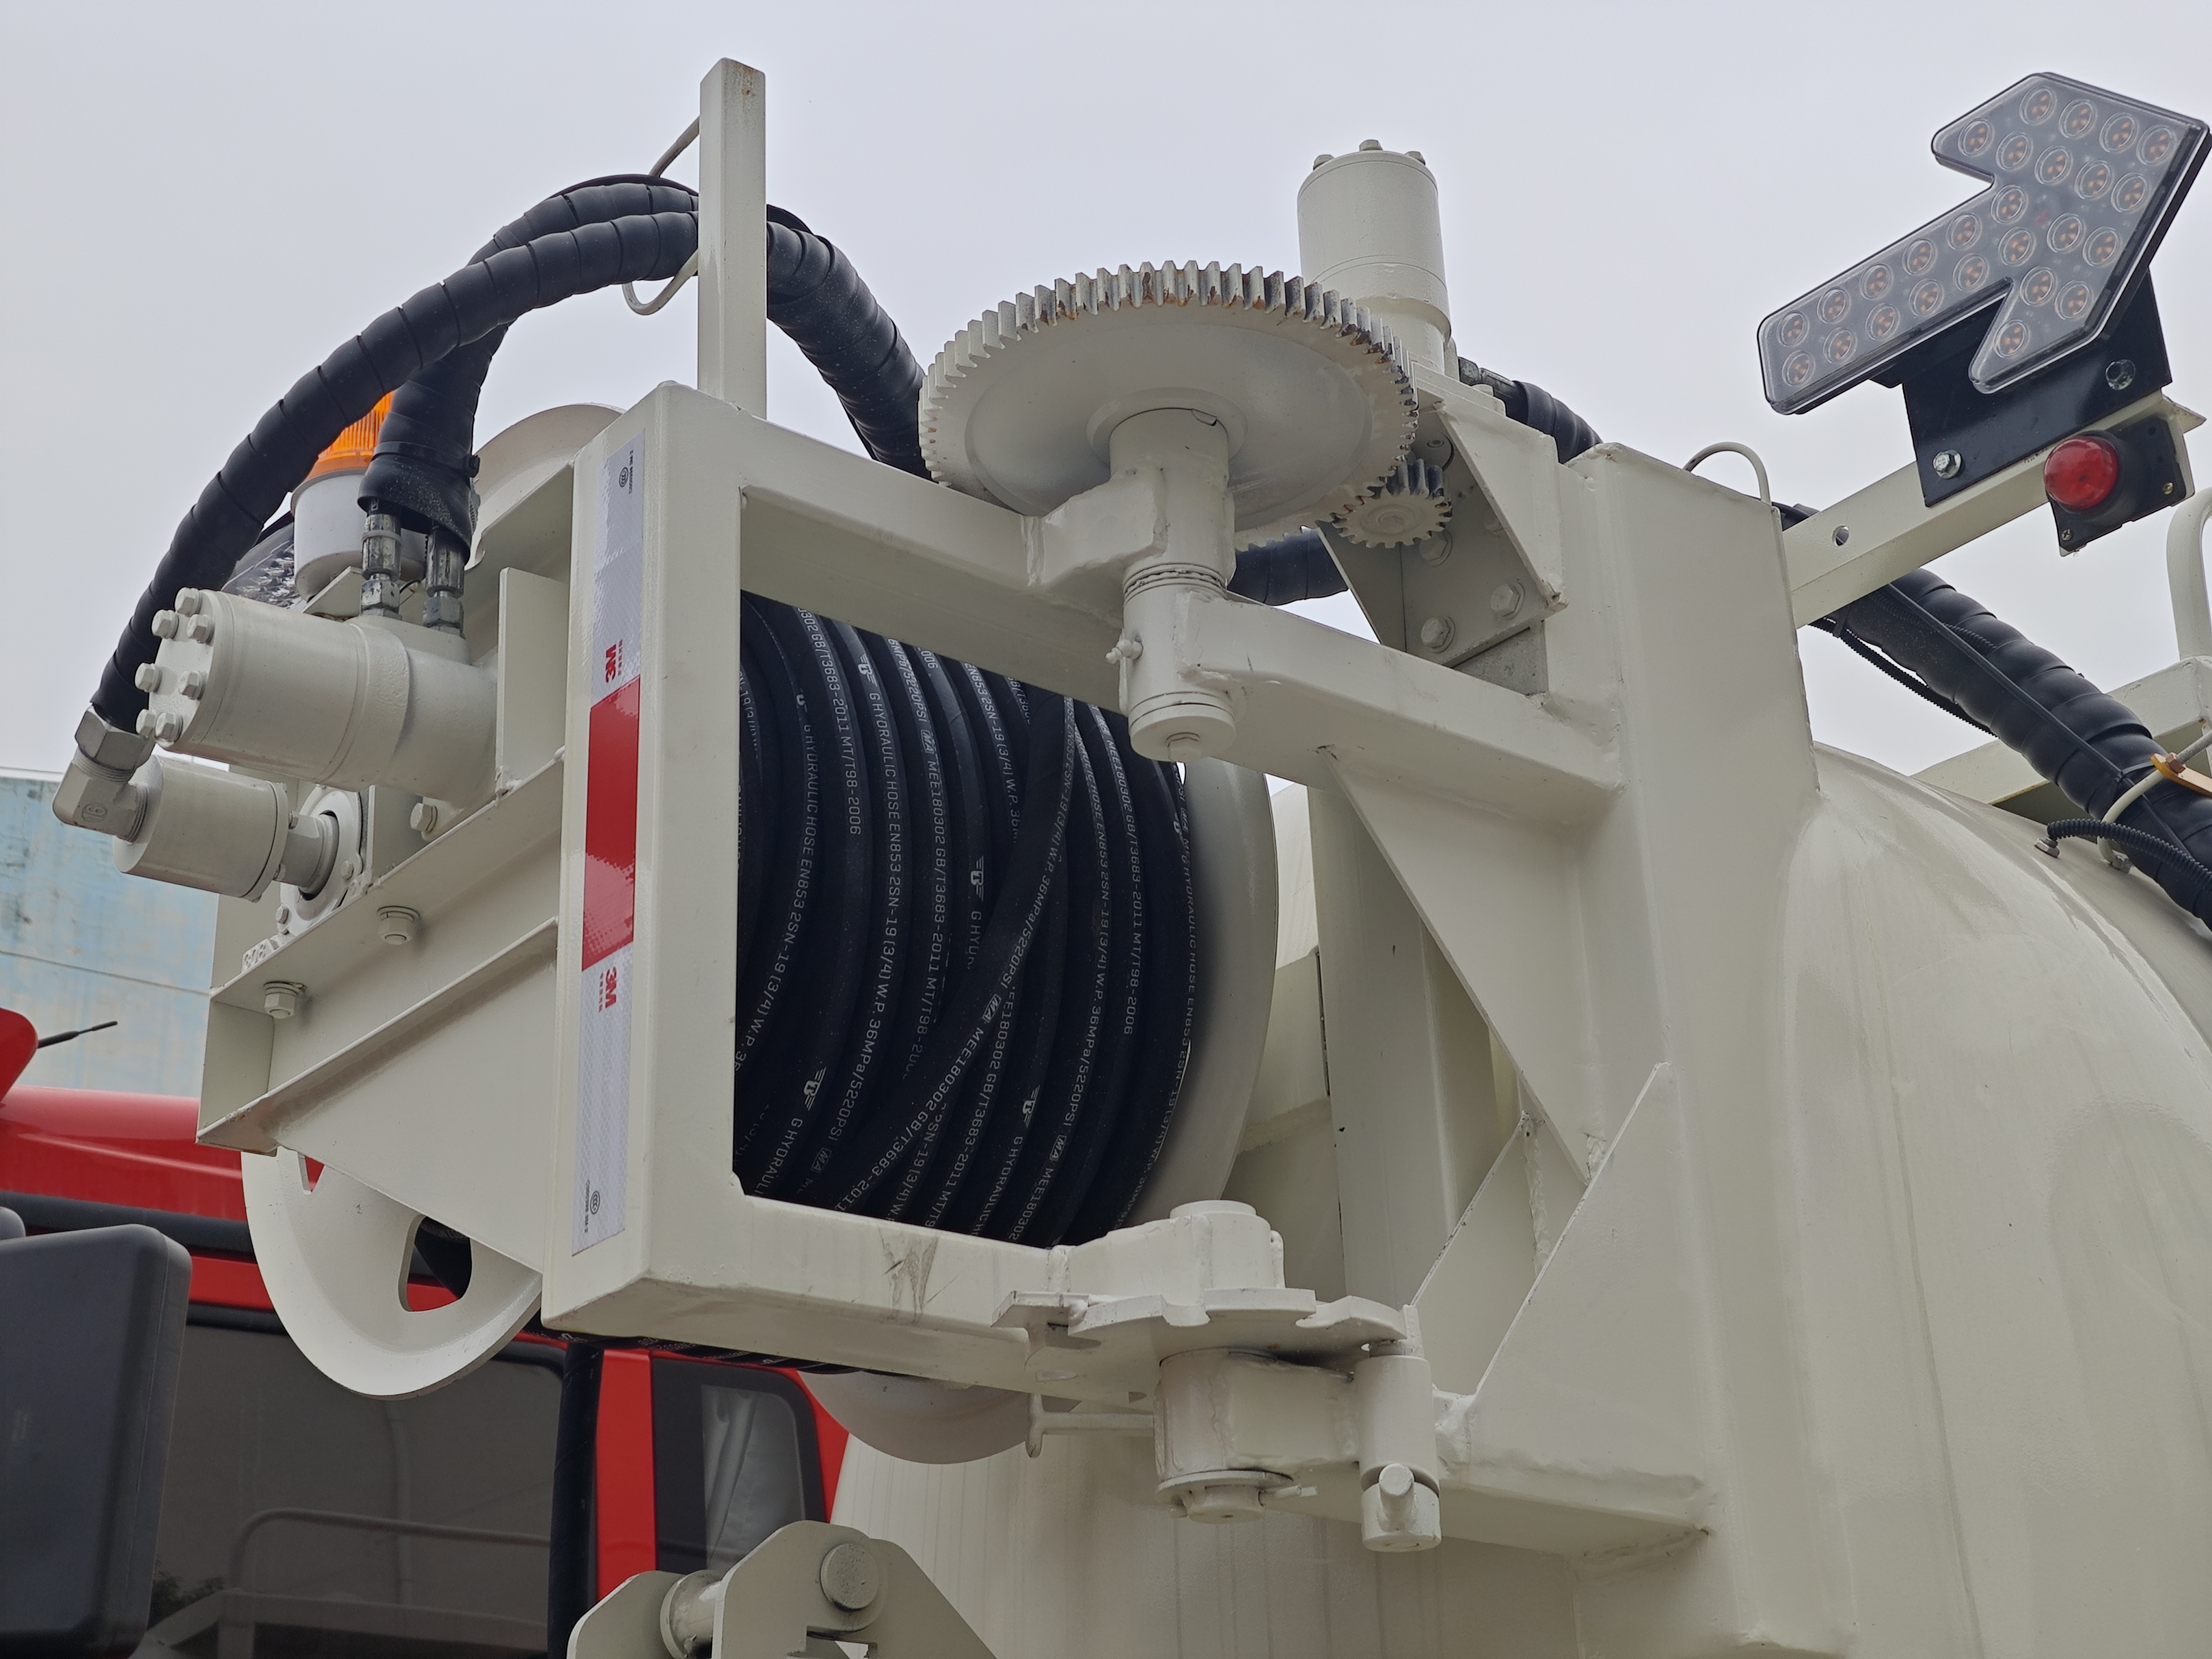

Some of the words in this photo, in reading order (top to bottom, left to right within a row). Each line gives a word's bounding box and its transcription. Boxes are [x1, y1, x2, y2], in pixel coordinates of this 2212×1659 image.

[605, 644, 616, 683] 3M
[869, 693, 881, 701] G
[811, 633, 849, 732] GB/T3683-2011
[840, 736, 861, 835] MT/T98-2006
[872, 703, 896, 778] HYDRAULIC
[981, 697, 1006, 741] 2SN-19
[1006, 779, 1019, 805] W.P.
[806, 736, 819, 813] HYDRAULIC
[887, 781, 900, 819] HOSE
[927, 760, 946, 844] MEE180302
[1060, 763, 1073, 811] 2SN-19
[1091, 785, 1104, 819] HOSE
[1107, 740, 1133, 812] MEE180302
[802, 816, 817, 857] HOSE
[889, 823, 901, 873] EN853
[1044, 847, 1058, 873] W.P.
[1096, 822, 1108, 868] EN853
[794, 859, 812, 909] EN853
[1101, 872, 1109, 928] 2SN-19
[1125, 814, 1142, 928] GB/T3683-2011
[885, 877, 901, 937] 2SN-19
[928, 848, 946, 972] GB/T3683-2011
[971, 910, 982, 921] G
[1000, 875, 1050, 989] 36MPa/5220PSI
[1183, 867, 1196, 948] HYDRAULIC
[774, 912, 802, 973] 2SN-19
[605, 967, 617, 1008] 3M
[873, 983, 890, 1014] W.P.
[1094, 972, 1106, 1002] W.P.
[1124, 932, 1142, 1035] MT/T98-2006
[741, 1019, 765, 1047] W.P.
[828, 1019, 881, 1141] 36MPa/5220PSI
[926, 1027, 984, 1111] MEE180302
[1063, 1006, 1102, 1126] 36MPa/5220PSI
[791, 1117, 803, 1128] G
[946, 1073, 997, 1187] GB/T3683-2011
[1013, 1136, 1023, 1145] G
[836, 1111, 928, 1211] GB/T3683-2011
[979, 1148, 1019, 1222] HYDRAULIC
[1008, 1168, 1055, 1240] MEE180302
